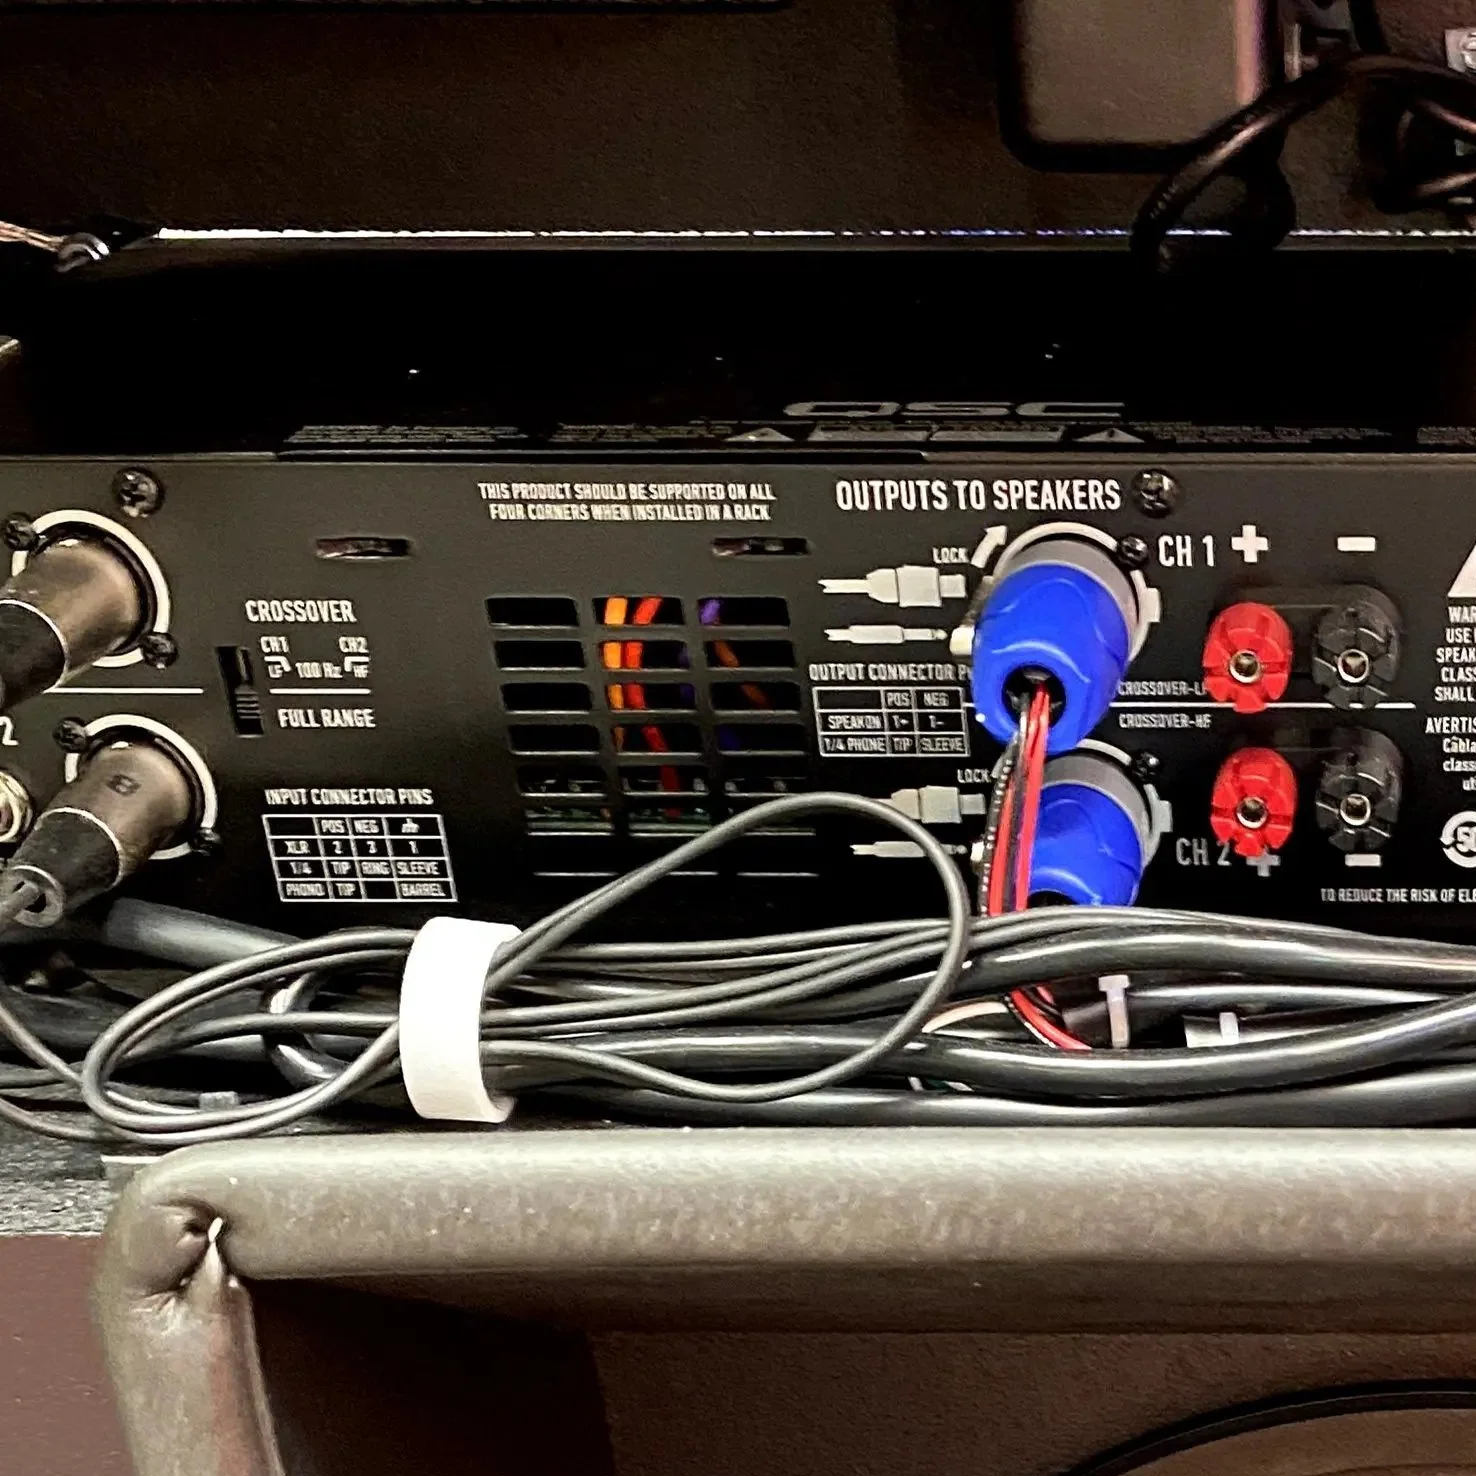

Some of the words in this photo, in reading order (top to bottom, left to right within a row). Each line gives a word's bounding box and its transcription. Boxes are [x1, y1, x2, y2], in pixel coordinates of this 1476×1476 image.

[477, 483, 510, 500] THIS
[511, 483, 573, 500] PRODUCT
[574, 483, 626, 500] SHOULD
[629, 483, 649, 500] BE
[650, 483, 725, 500] SUPPORTED
[727, 483, 747, 500] ON
[750, 483, 777, 500] ALL
[835, 479, 948, 511] OUTPUTS
[954, 479, 985, 511] TO
[992, 479, 1121, 511] SPEAKERS
[489, 504, 525, 520] FOUR
[527, 504, 590, 520] CORNERS
[591, 504, 631, 520] WHEN
[632, 504, 704, 520] INSTALLED
[705, 504, 720, 520] IN
[722, 504, 735, 520] A
[932, 547, 968, 563] LOCK
[1158, 534, 1193, 567] CH
[1202, 534, 1215, 567] 1
[245, 600, 357, 623] CROSSOVER
[1446, 628, 1472, 643] USE
[295, 662, 322, 678] 100
[323, 662, 343, 678] Hz
[809, 663, 864, 681] OUTPUT
[868, 663, 956, 681] CONNECTOR
[886, 692, 911, 706] POS
[923, 692, 949, 706] NEG
[1434, 686, 1475, 702] SHALL
[277, 709, 321, 728] FULL
[320, 709, 377, 728] RANGE
[828, 715, 882, 729] SPEAKON
[847, 737, 886, 751] PHONE
[892, 737, 913, 751] TIP
[919, 737, 964, 751] SLEEVE
[957, 768, 991, 783] LOCK
[264, 788, 308, 805] INPUT
[310, 788, 397, 805] CONNECTOR
[398, 788, 434, 805] PINS
[321, 820, 346, 833] POS
[353, 820, 380, 833] NEG
[284, 840, 311, 854] XLR
[332, 840, 344, 854] 2
[408, 840, 419, 854] 1
[1176, 838, 1210, 867] CH
[1215, 838, 1232, 867] 2
[330, 861, 351, 875] TIP
[361, 861, 390, 875] RING
[396, 861, 441, 875] SLEEVE
[286, 883, 326, 896] PHONO
[335, 883, 356, 896] TIP
[400, 883, 446, 896] BARREL
[1321, 888, 1336, 903] TO
[1338, 888, 1383, 903] REDUCE
[1386, 888, 1408, 903] THE
[1410, 888, 1439, 903] RISK
[1440, 888, 1455, 903] OF
